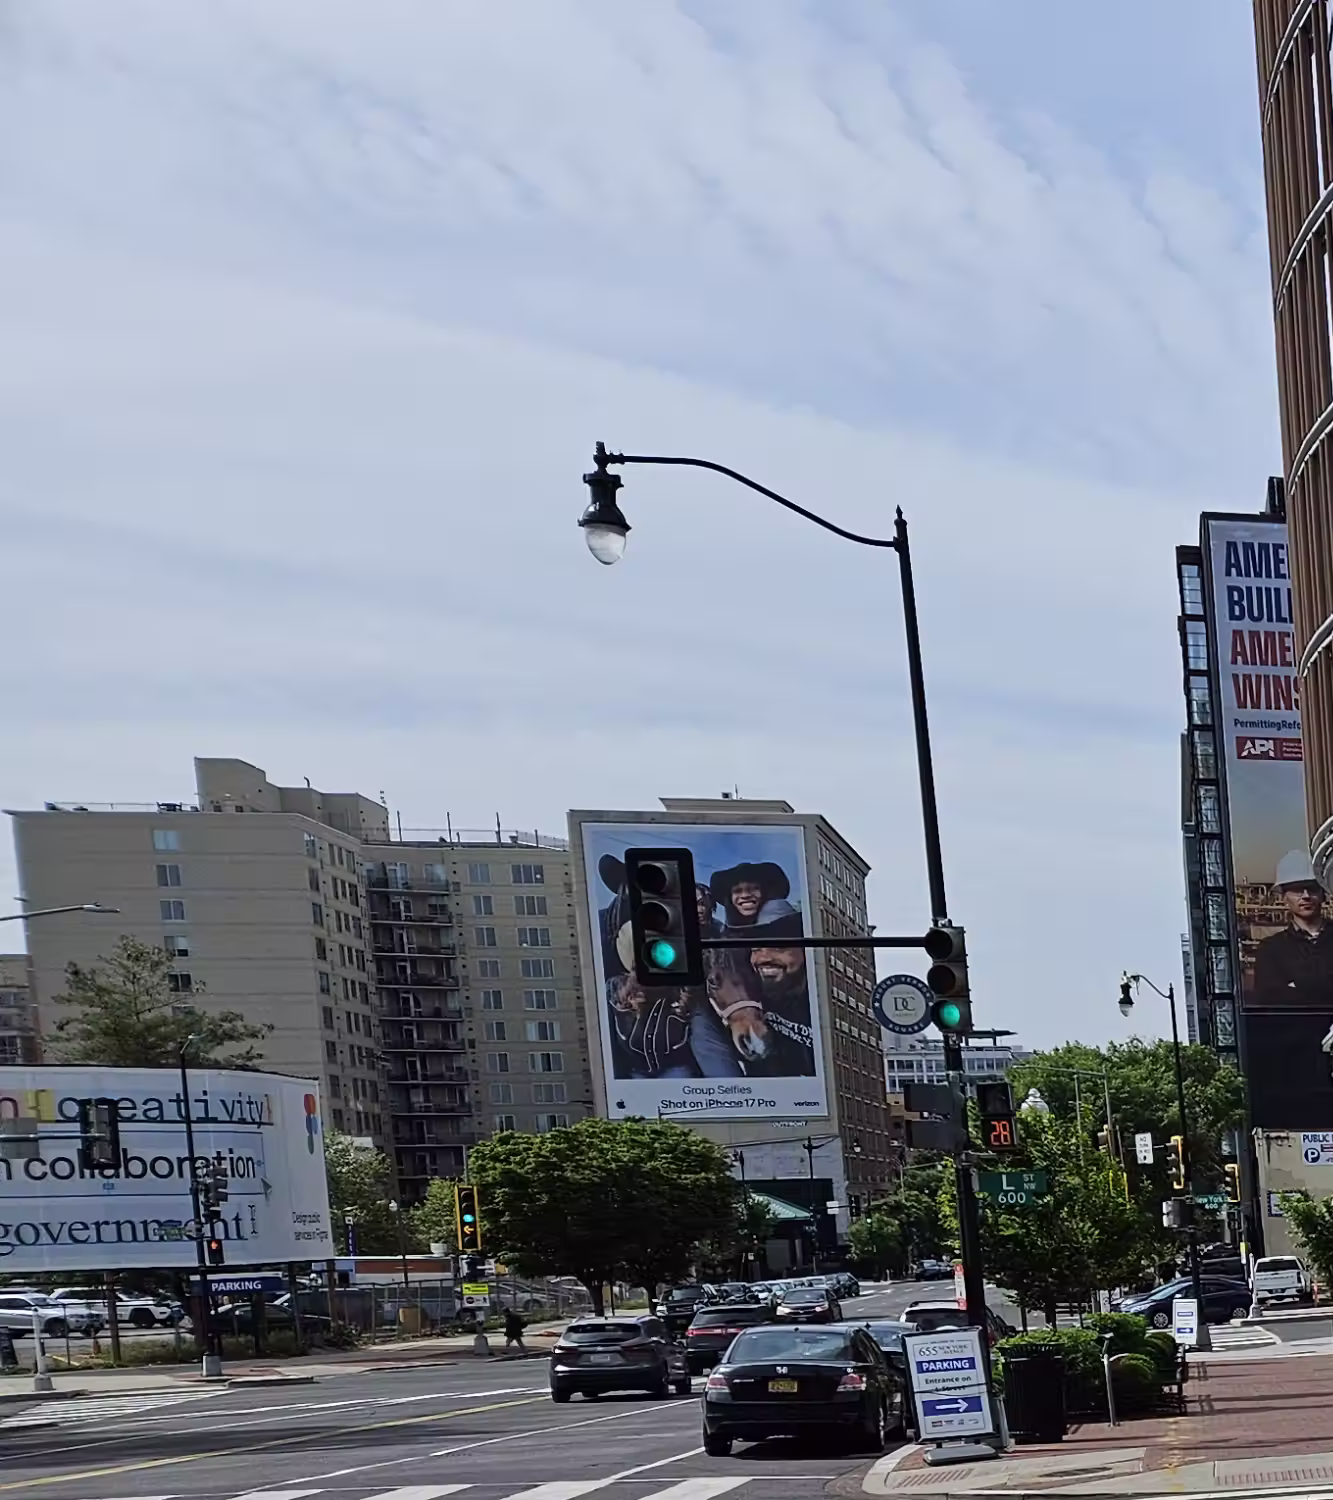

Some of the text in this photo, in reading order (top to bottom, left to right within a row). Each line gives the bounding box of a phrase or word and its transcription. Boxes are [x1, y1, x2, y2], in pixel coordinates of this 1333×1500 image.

[1241, 740, 1274, 757] API
[894, 996, 915, 1011] DC
[682, 1085, 752, 1095] Group Selfies
[661, 1100, 684, 1109] Shot
[745, 1099, 755, 1107] 17
[758, 1099, 776, 1107] Pro
[57, 1090, 264, 1129] ceativity
[990, 1121, 1011, 1145] 28
[1303, 1134, 1330, 1143] PUBLIC
[1002, 1175, 1016, 1190] L
[1023, 1182, 1036, 1190] NW
[998, 1192, 1026, 1204] 600
[211, 1281, 262, 1291] PARKING
[919, 1346, 938, 1356] 655
[922, 1360, 969, 1371] PARKING
[925, 1377, 960, 1385] Entrance
